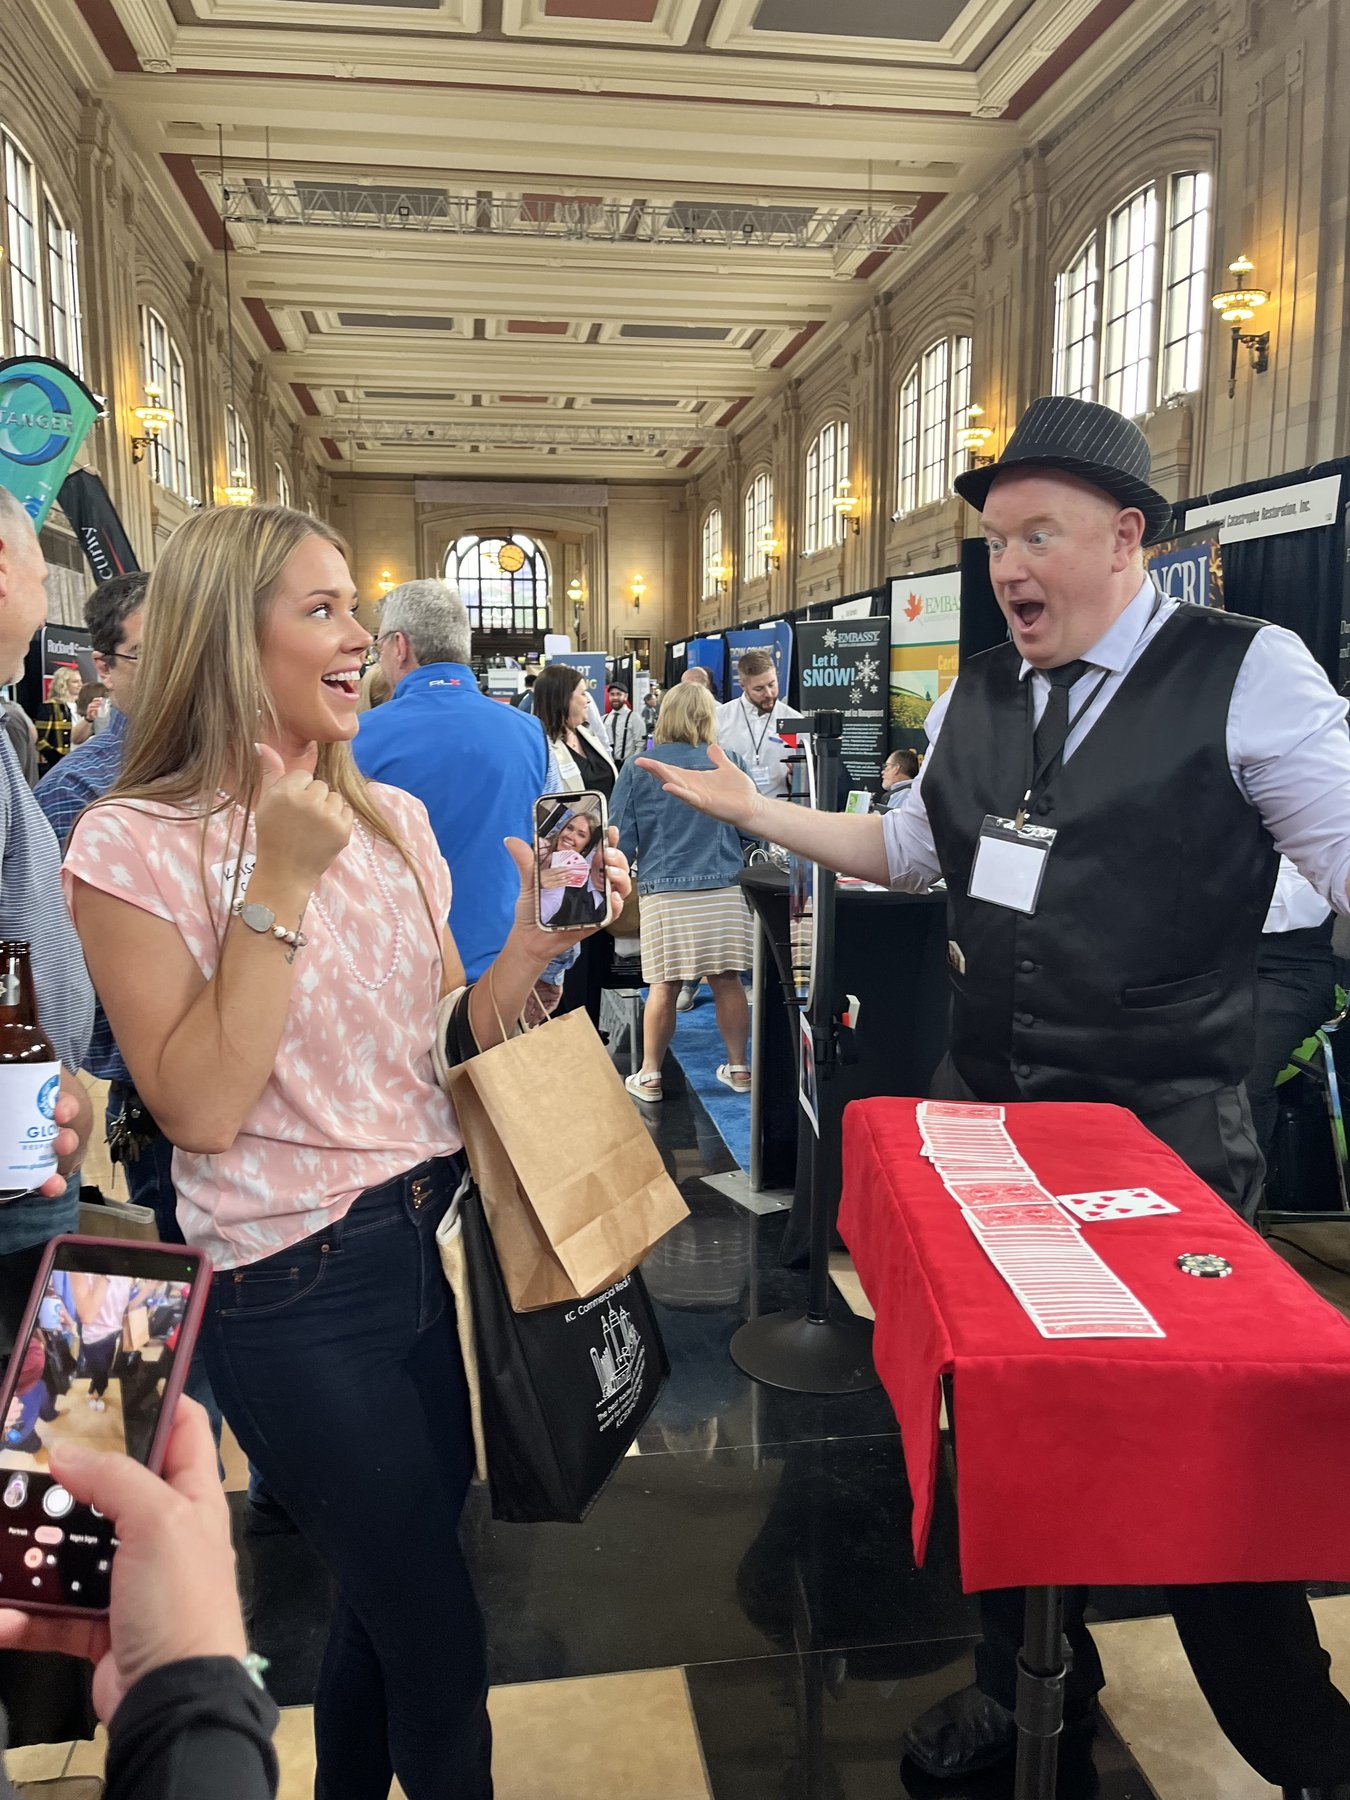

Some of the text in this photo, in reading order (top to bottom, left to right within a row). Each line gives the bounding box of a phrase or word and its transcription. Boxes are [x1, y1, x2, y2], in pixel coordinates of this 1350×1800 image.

[1150, 556, 1208, 607] NCRI
[838, 630, 881, 643] EMBASSY
[812, 652, 839, 667] Let it
[802, 667, 856, 688] SNOW!
[564, 1310, 577, 1323] KC
[577, 1285, 616, 1316] Commercial
